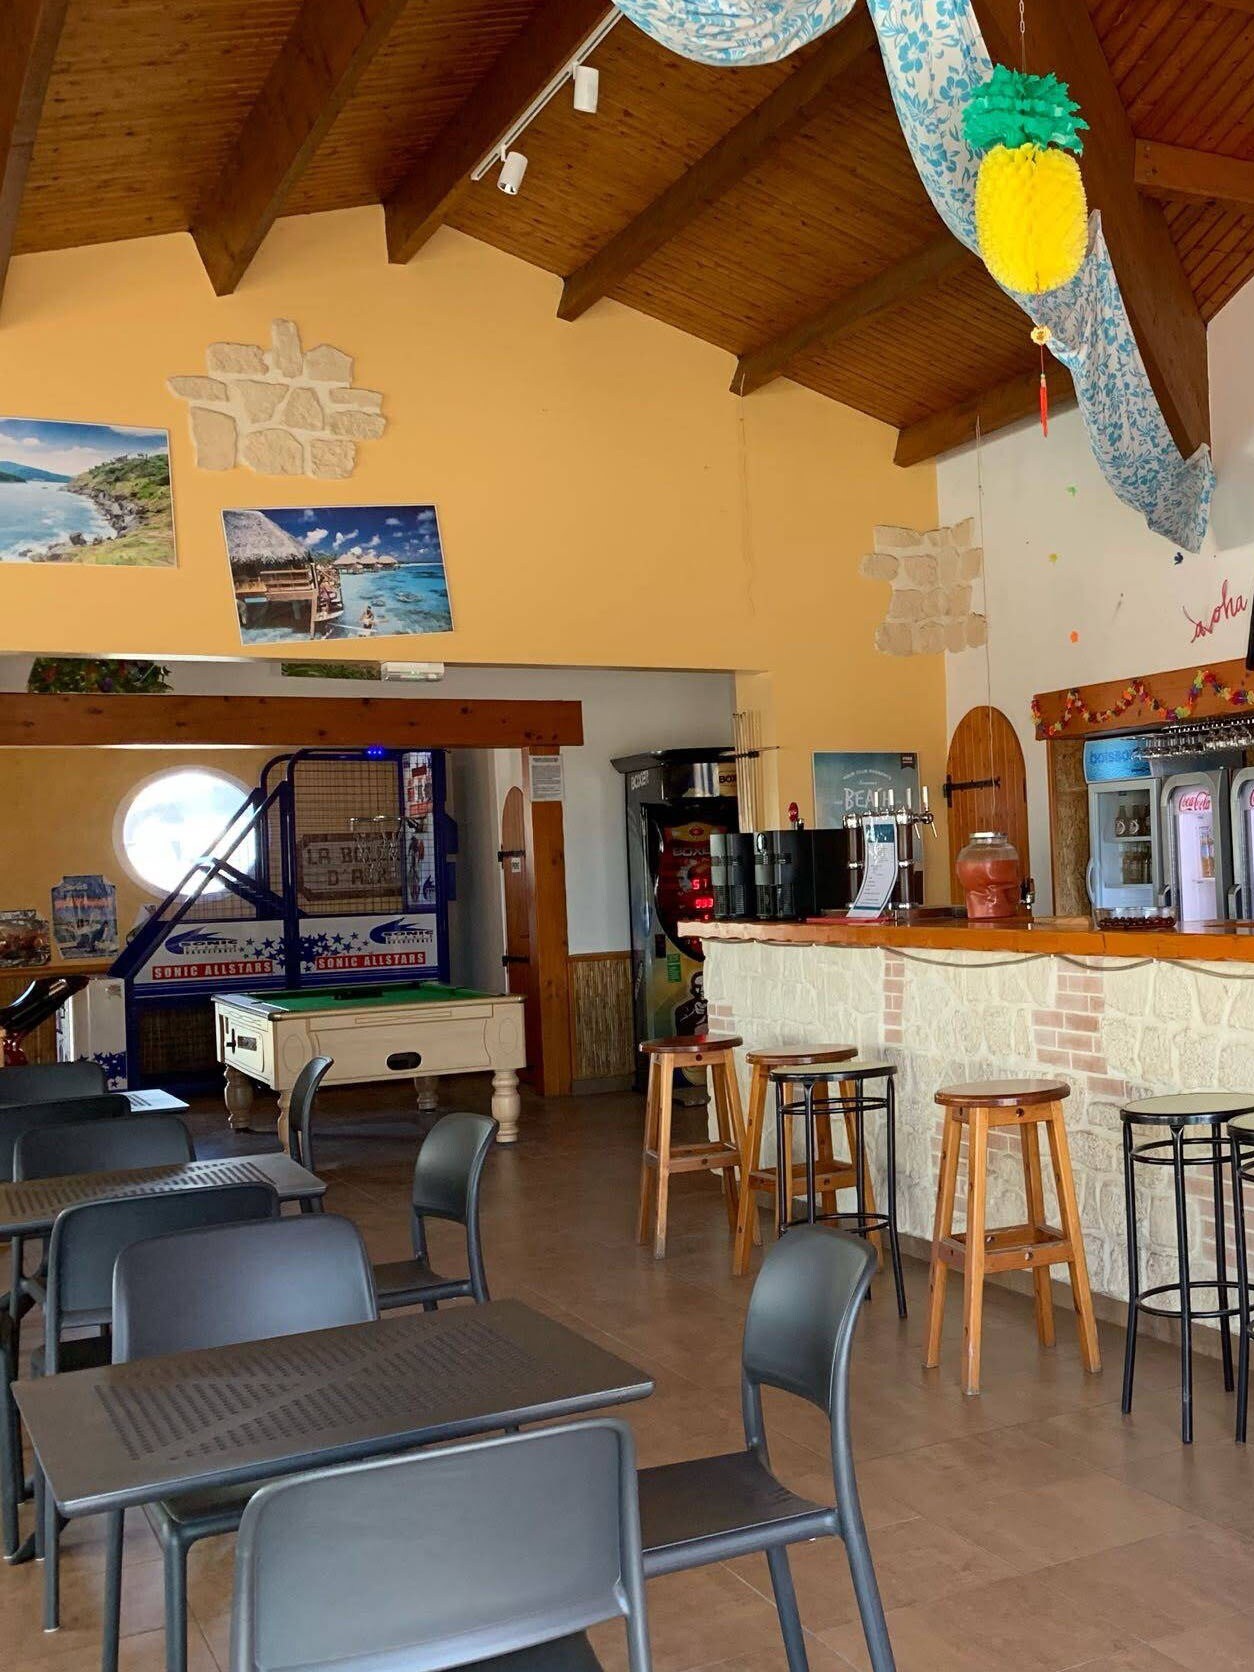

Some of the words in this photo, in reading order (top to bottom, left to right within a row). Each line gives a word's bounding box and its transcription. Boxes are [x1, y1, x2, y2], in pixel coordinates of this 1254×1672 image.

[719, 773, 737, 784] BOX
[318, 957, 358, 969] SONIC
[363, 952, 425, 967] ALLSTARS
[154, 964, 199, 979] SONIC
[204, 961, 272, 977] ALLSTARS
